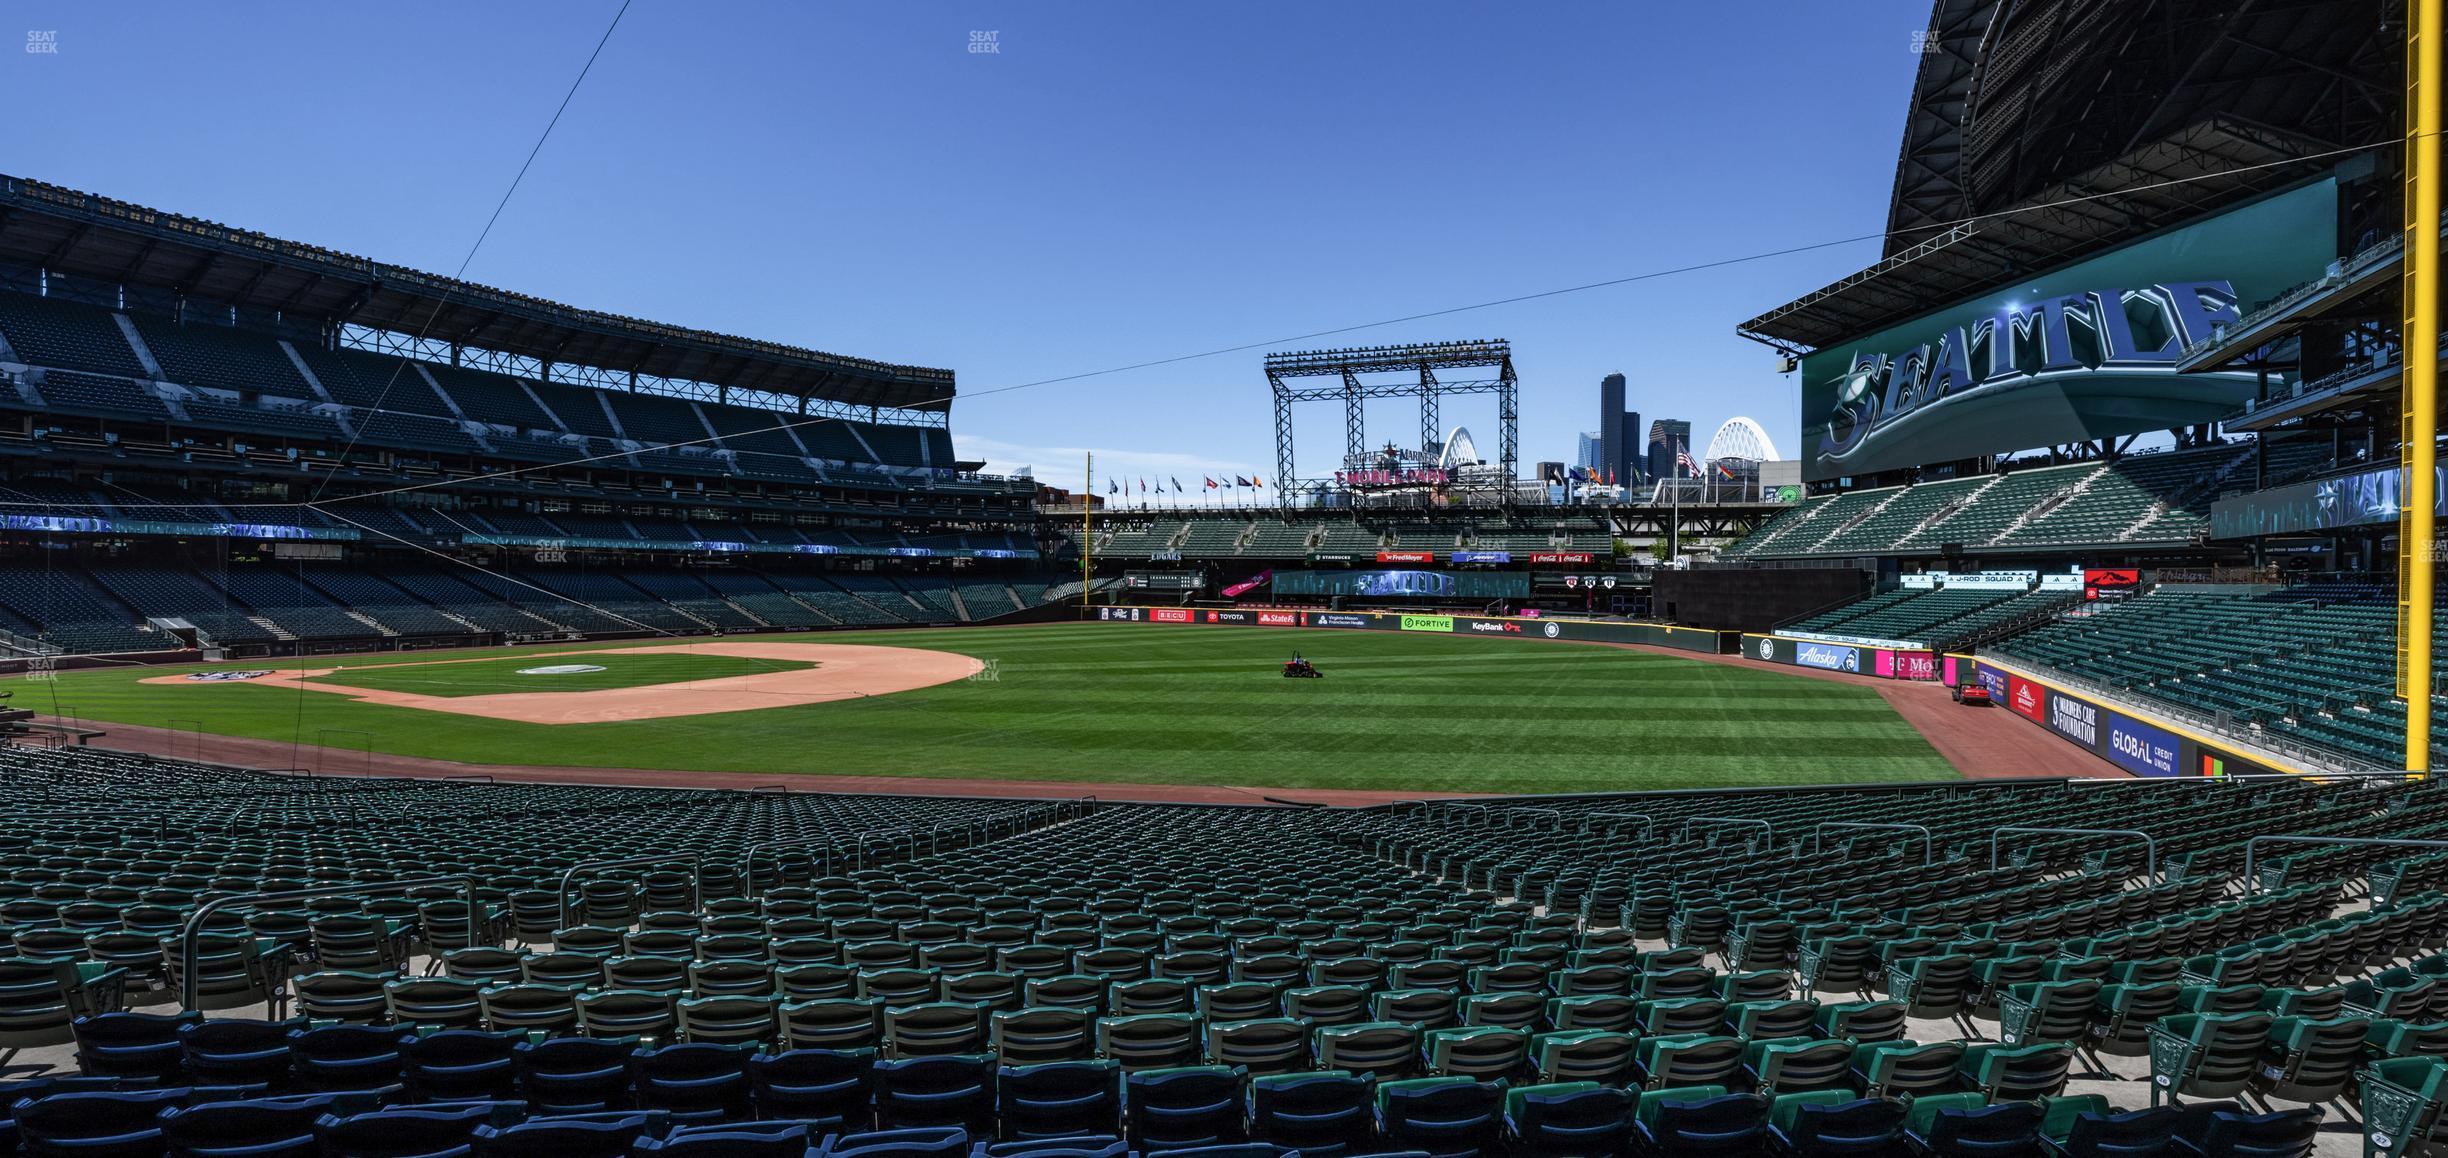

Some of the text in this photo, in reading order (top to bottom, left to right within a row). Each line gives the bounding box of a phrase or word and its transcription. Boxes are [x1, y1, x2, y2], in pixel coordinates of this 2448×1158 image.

[1407, 468, 1449, 483] PARK
[1415, 619, 1450, 628] FORTIVE
[1472, 621, 1503, 632] KeyBank
[1800, 647, 1838, 666] Alaska
[2082, 705, 2096, 726] CARE
[2059, 712, 2096, 746] FOUNDATION
[2113, 729, 2173, 764] GLOBAL CREDIT
[2153, 758, 2171, 773] UNION
